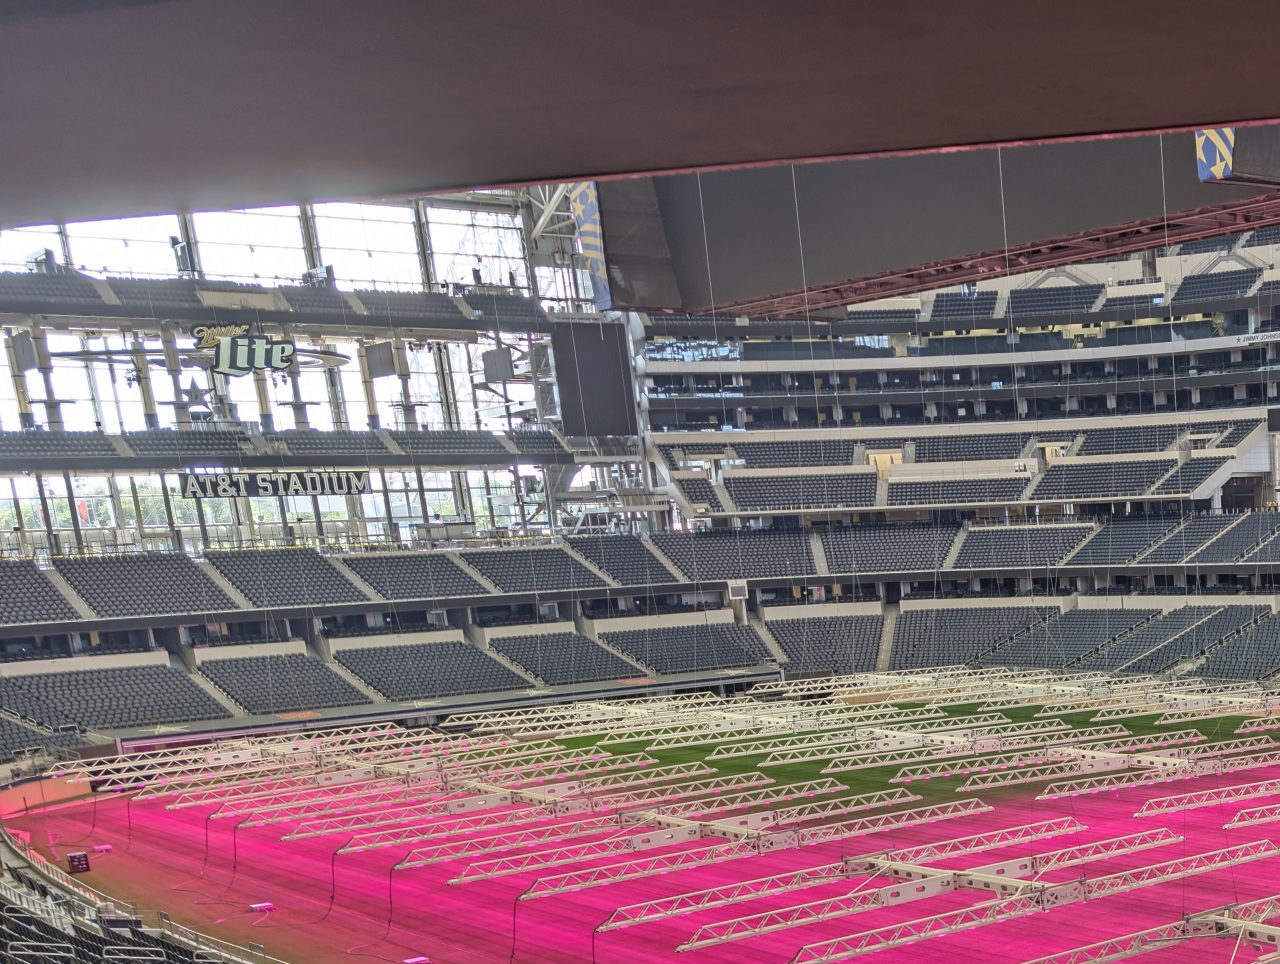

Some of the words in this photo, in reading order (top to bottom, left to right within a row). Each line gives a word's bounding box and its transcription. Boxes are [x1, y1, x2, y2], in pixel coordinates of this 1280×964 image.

[215, 336, 294, 376] Lite
[185, 474, 249, 498] AT&T
[256, 472, 372, 497] STADIUM
